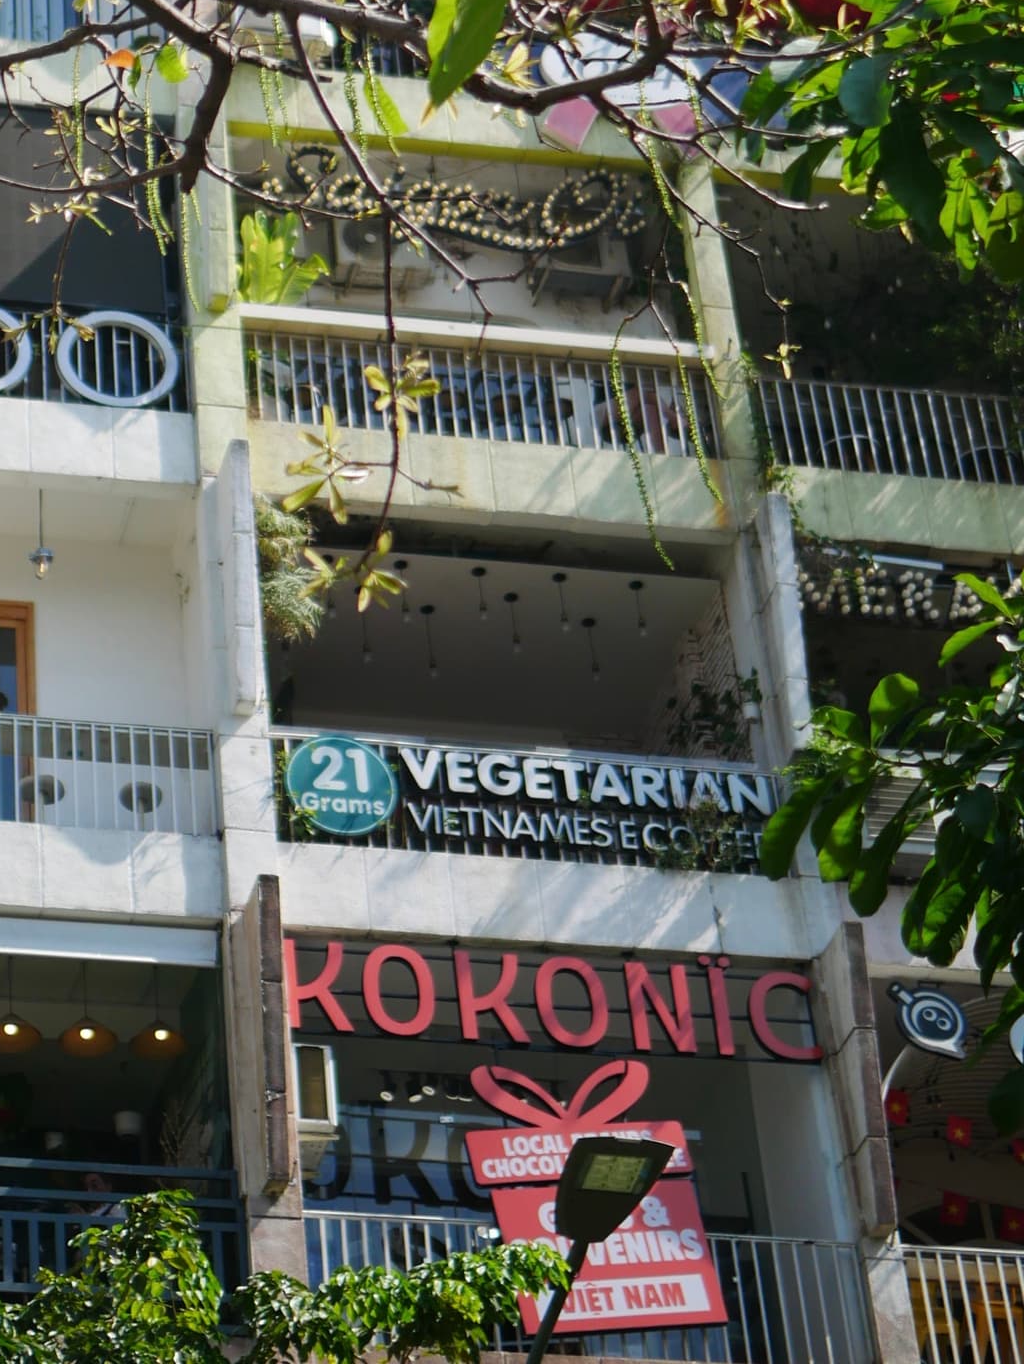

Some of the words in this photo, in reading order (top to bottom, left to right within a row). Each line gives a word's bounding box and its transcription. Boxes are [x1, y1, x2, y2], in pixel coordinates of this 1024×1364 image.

[310, 745, 369, 794] 21
[400, 747, 773, 816] VEGETARIAN
[301, 791, 385, 817] Grams
[282, 940, 823, 1060] KOKONÏC
[502, 1132, 568, 1156] LOCAL
[623, 1282, 687, 1310] NAM
